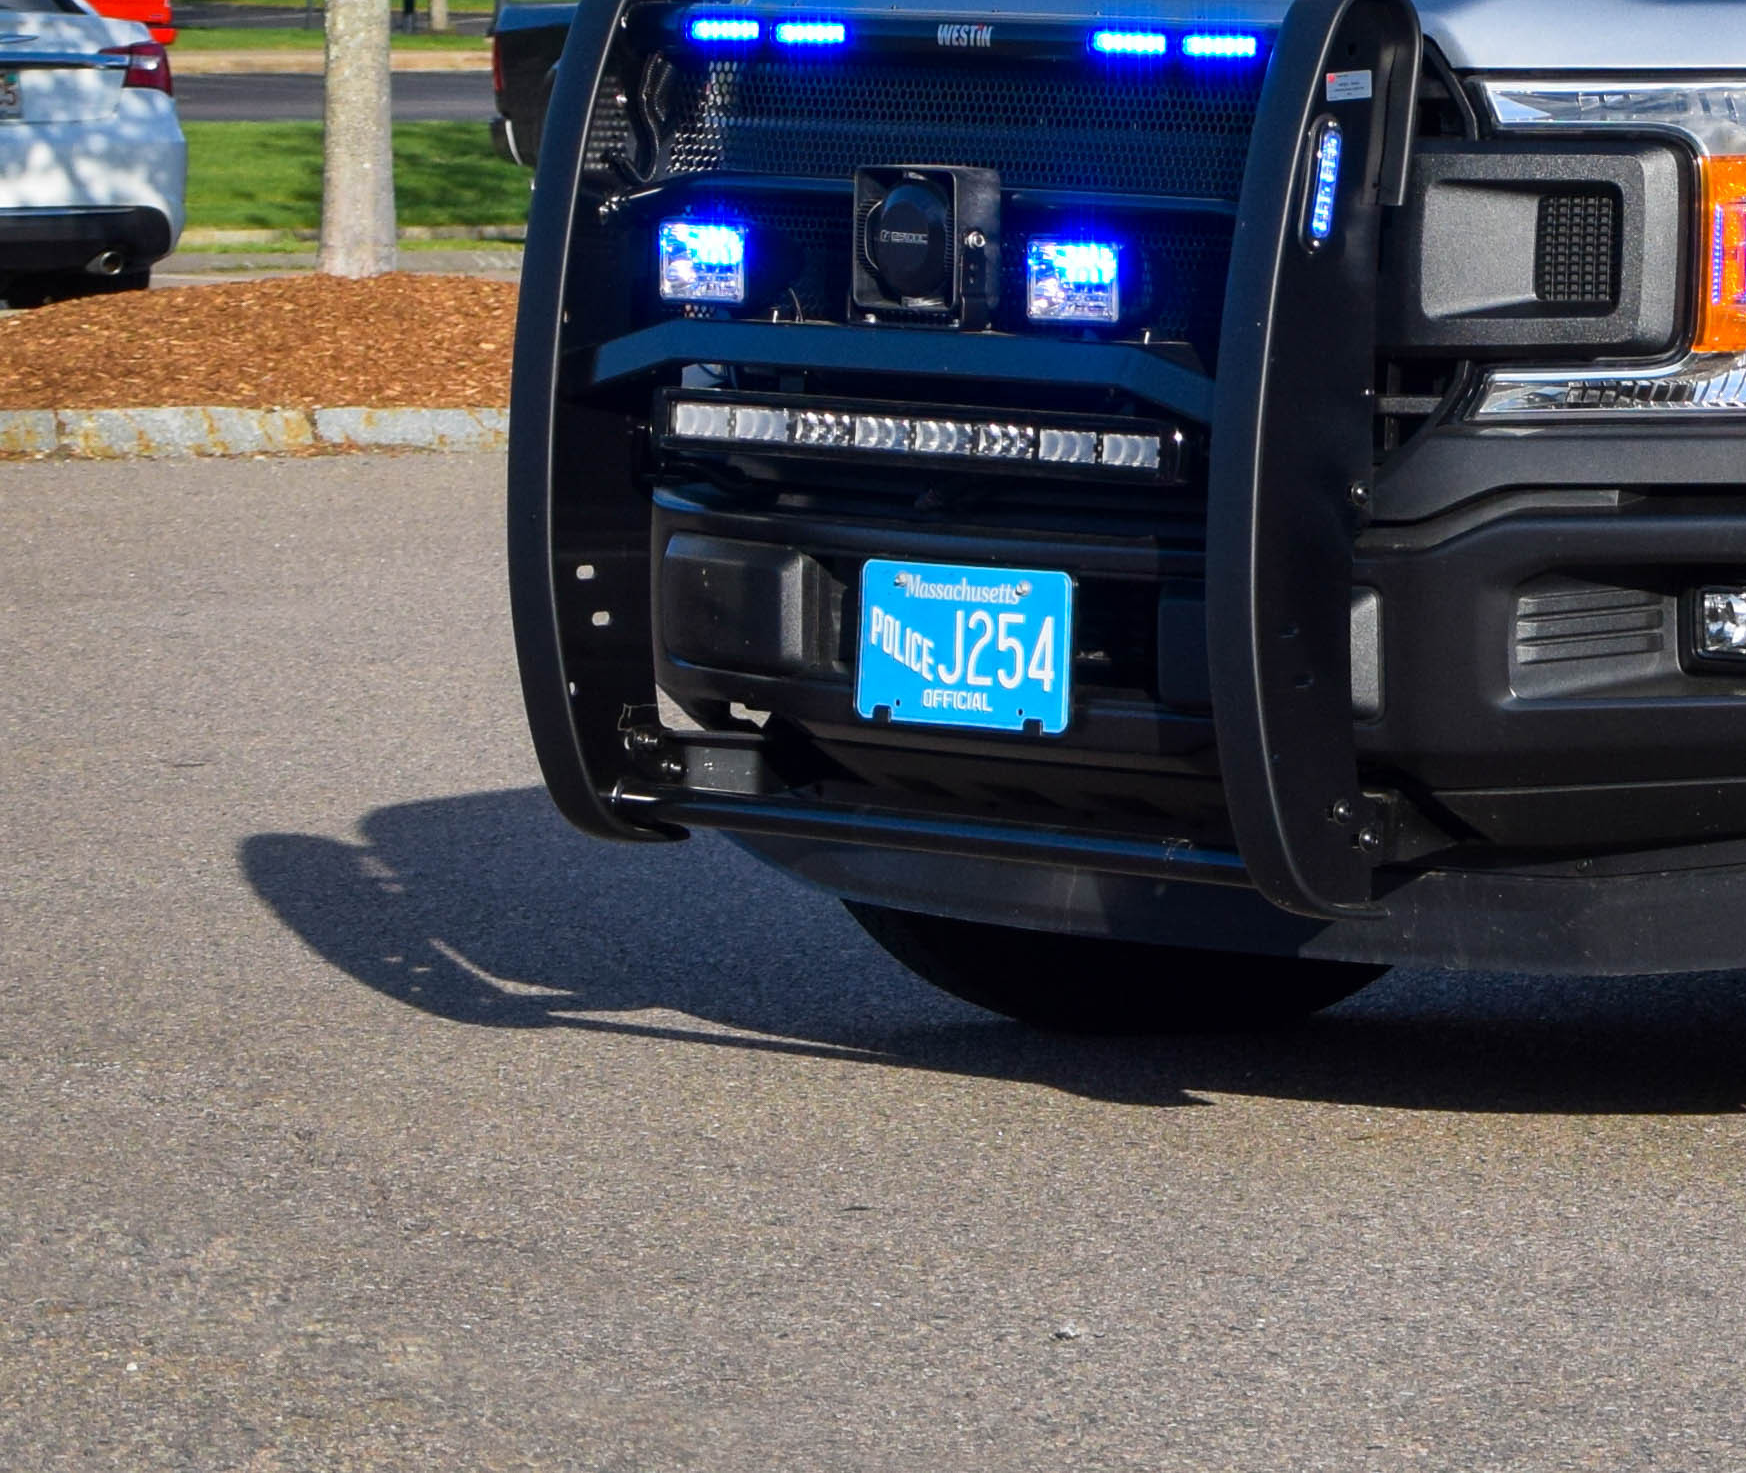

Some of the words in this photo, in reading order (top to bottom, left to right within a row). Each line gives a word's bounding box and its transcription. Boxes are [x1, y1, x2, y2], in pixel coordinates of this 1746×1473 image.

[904, 573, 1020, 605] Massachusetts
[870, 606, 935, 682] POLICE
[936, 610, 1055, 693] J254
[922, 689, 993, 712] OFFICIAL
